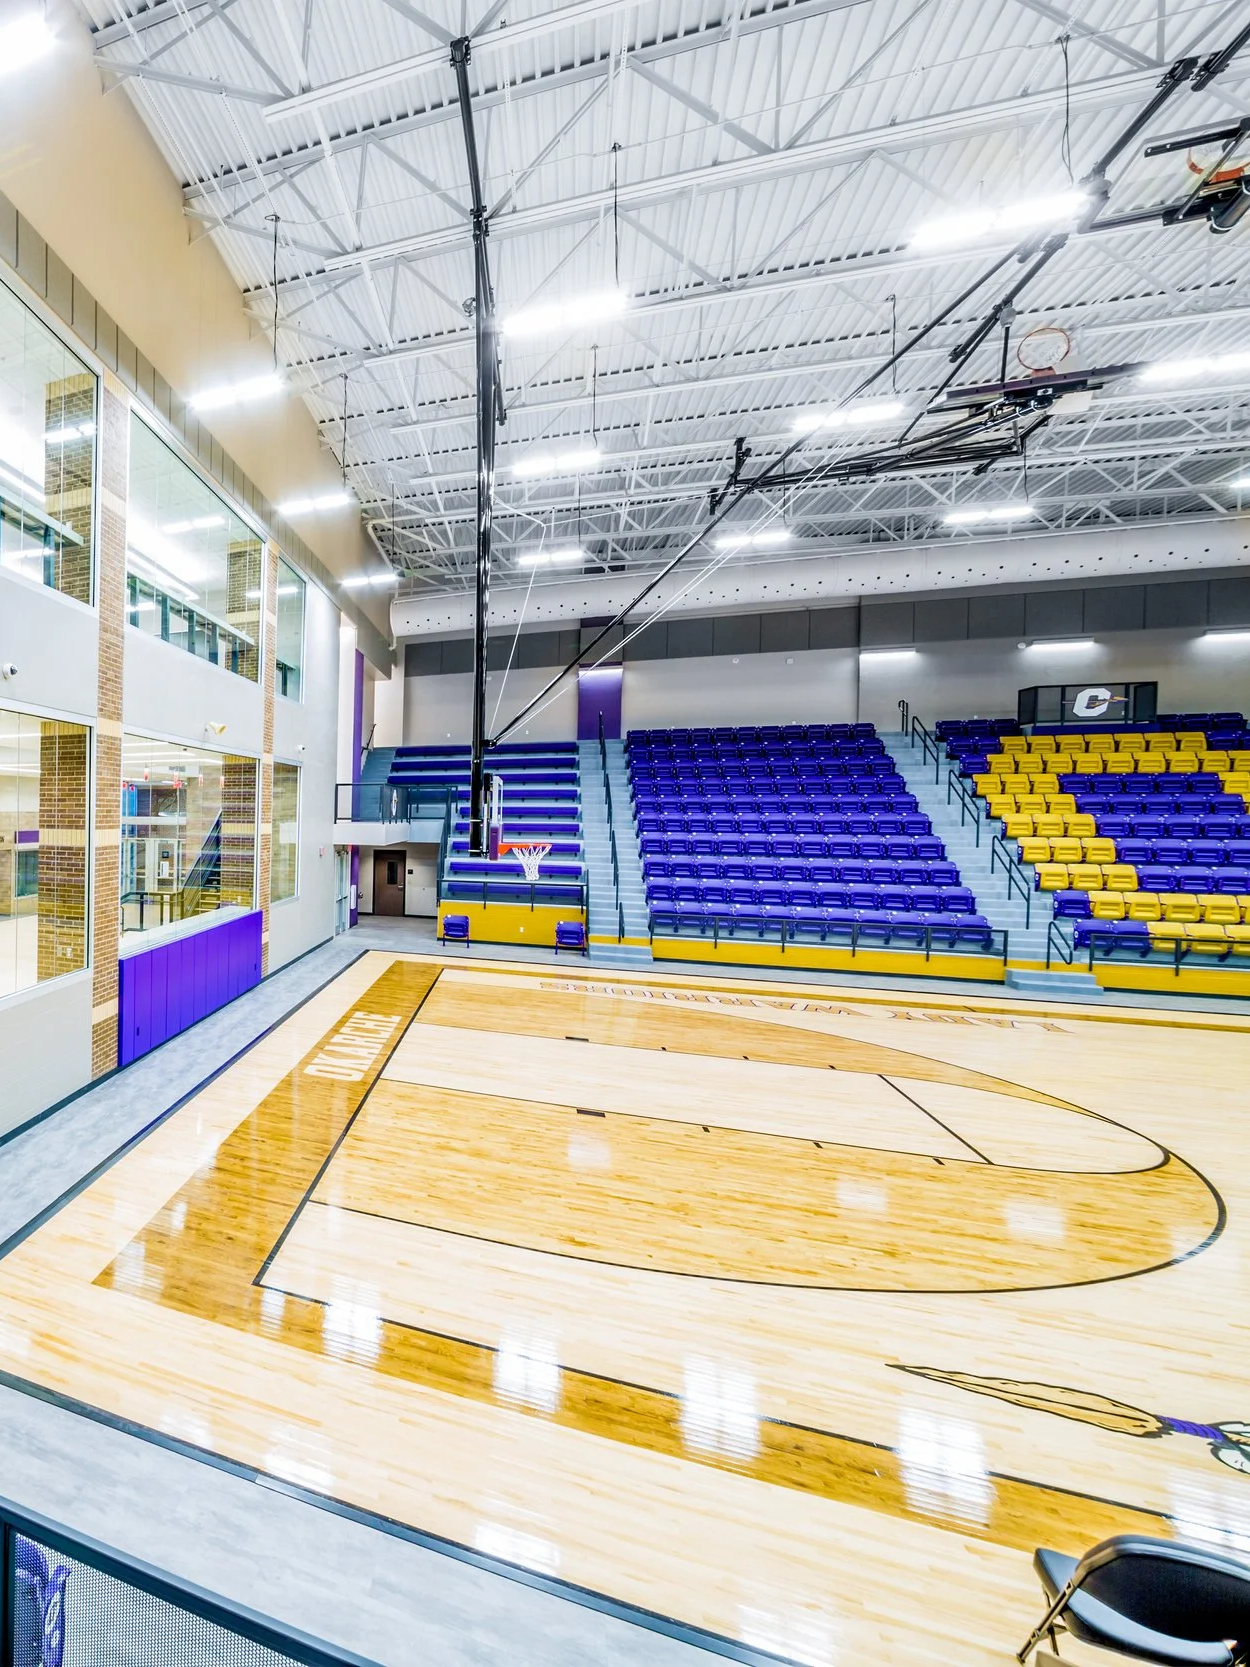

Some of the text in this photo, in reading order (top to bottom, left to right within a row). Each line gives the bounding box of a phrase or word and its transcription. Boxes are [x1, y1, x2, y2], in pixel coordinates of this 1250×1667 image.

[1072, 687, 1112, 717] C
[539, 981, 872, 1018] WARRIORS
[302, 1011, 402, 1082] OKARCHE
